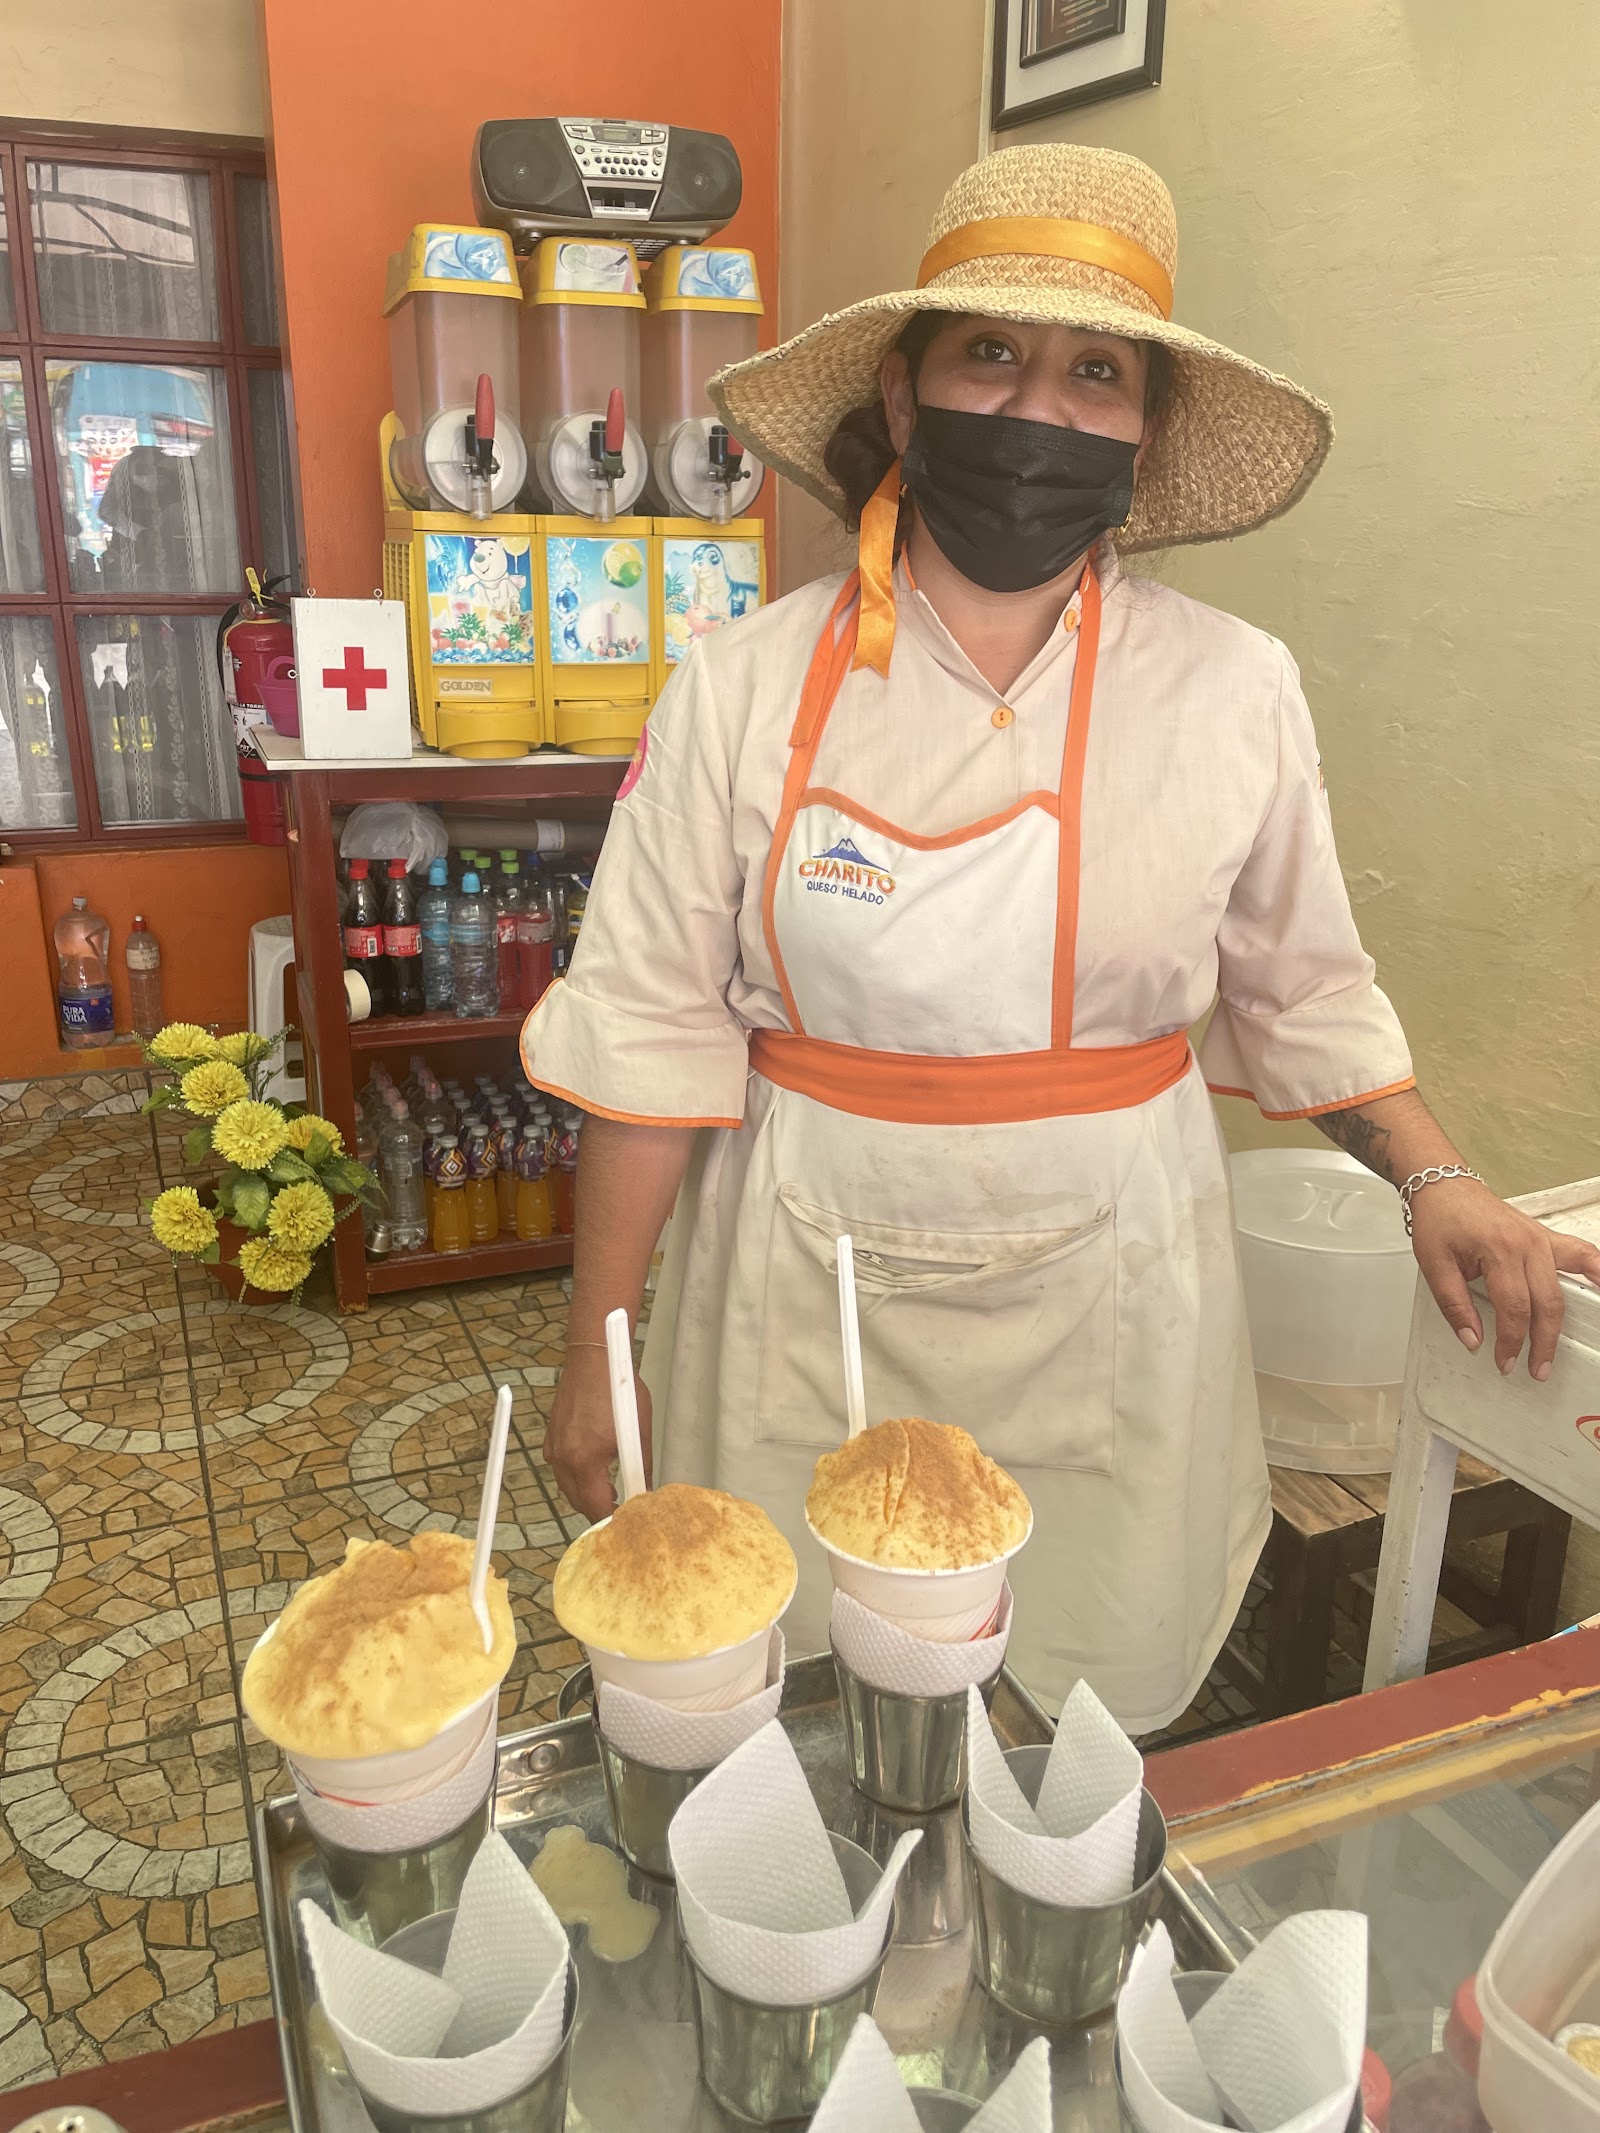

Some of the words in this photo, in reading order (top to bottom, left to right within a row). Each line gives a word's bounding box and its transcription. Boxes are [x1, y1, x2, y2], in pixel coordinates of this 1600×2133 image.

[440, 681, 491, 692] GOLDEN
[799, 858, 896, 894] CHARITO
[807, 881, 838, 894] QUESO
[842, 887, 884, 905] HELADO
[62, 1005, 85, 1015] PURA
[65, 1012, 87, 1022] VIDA
